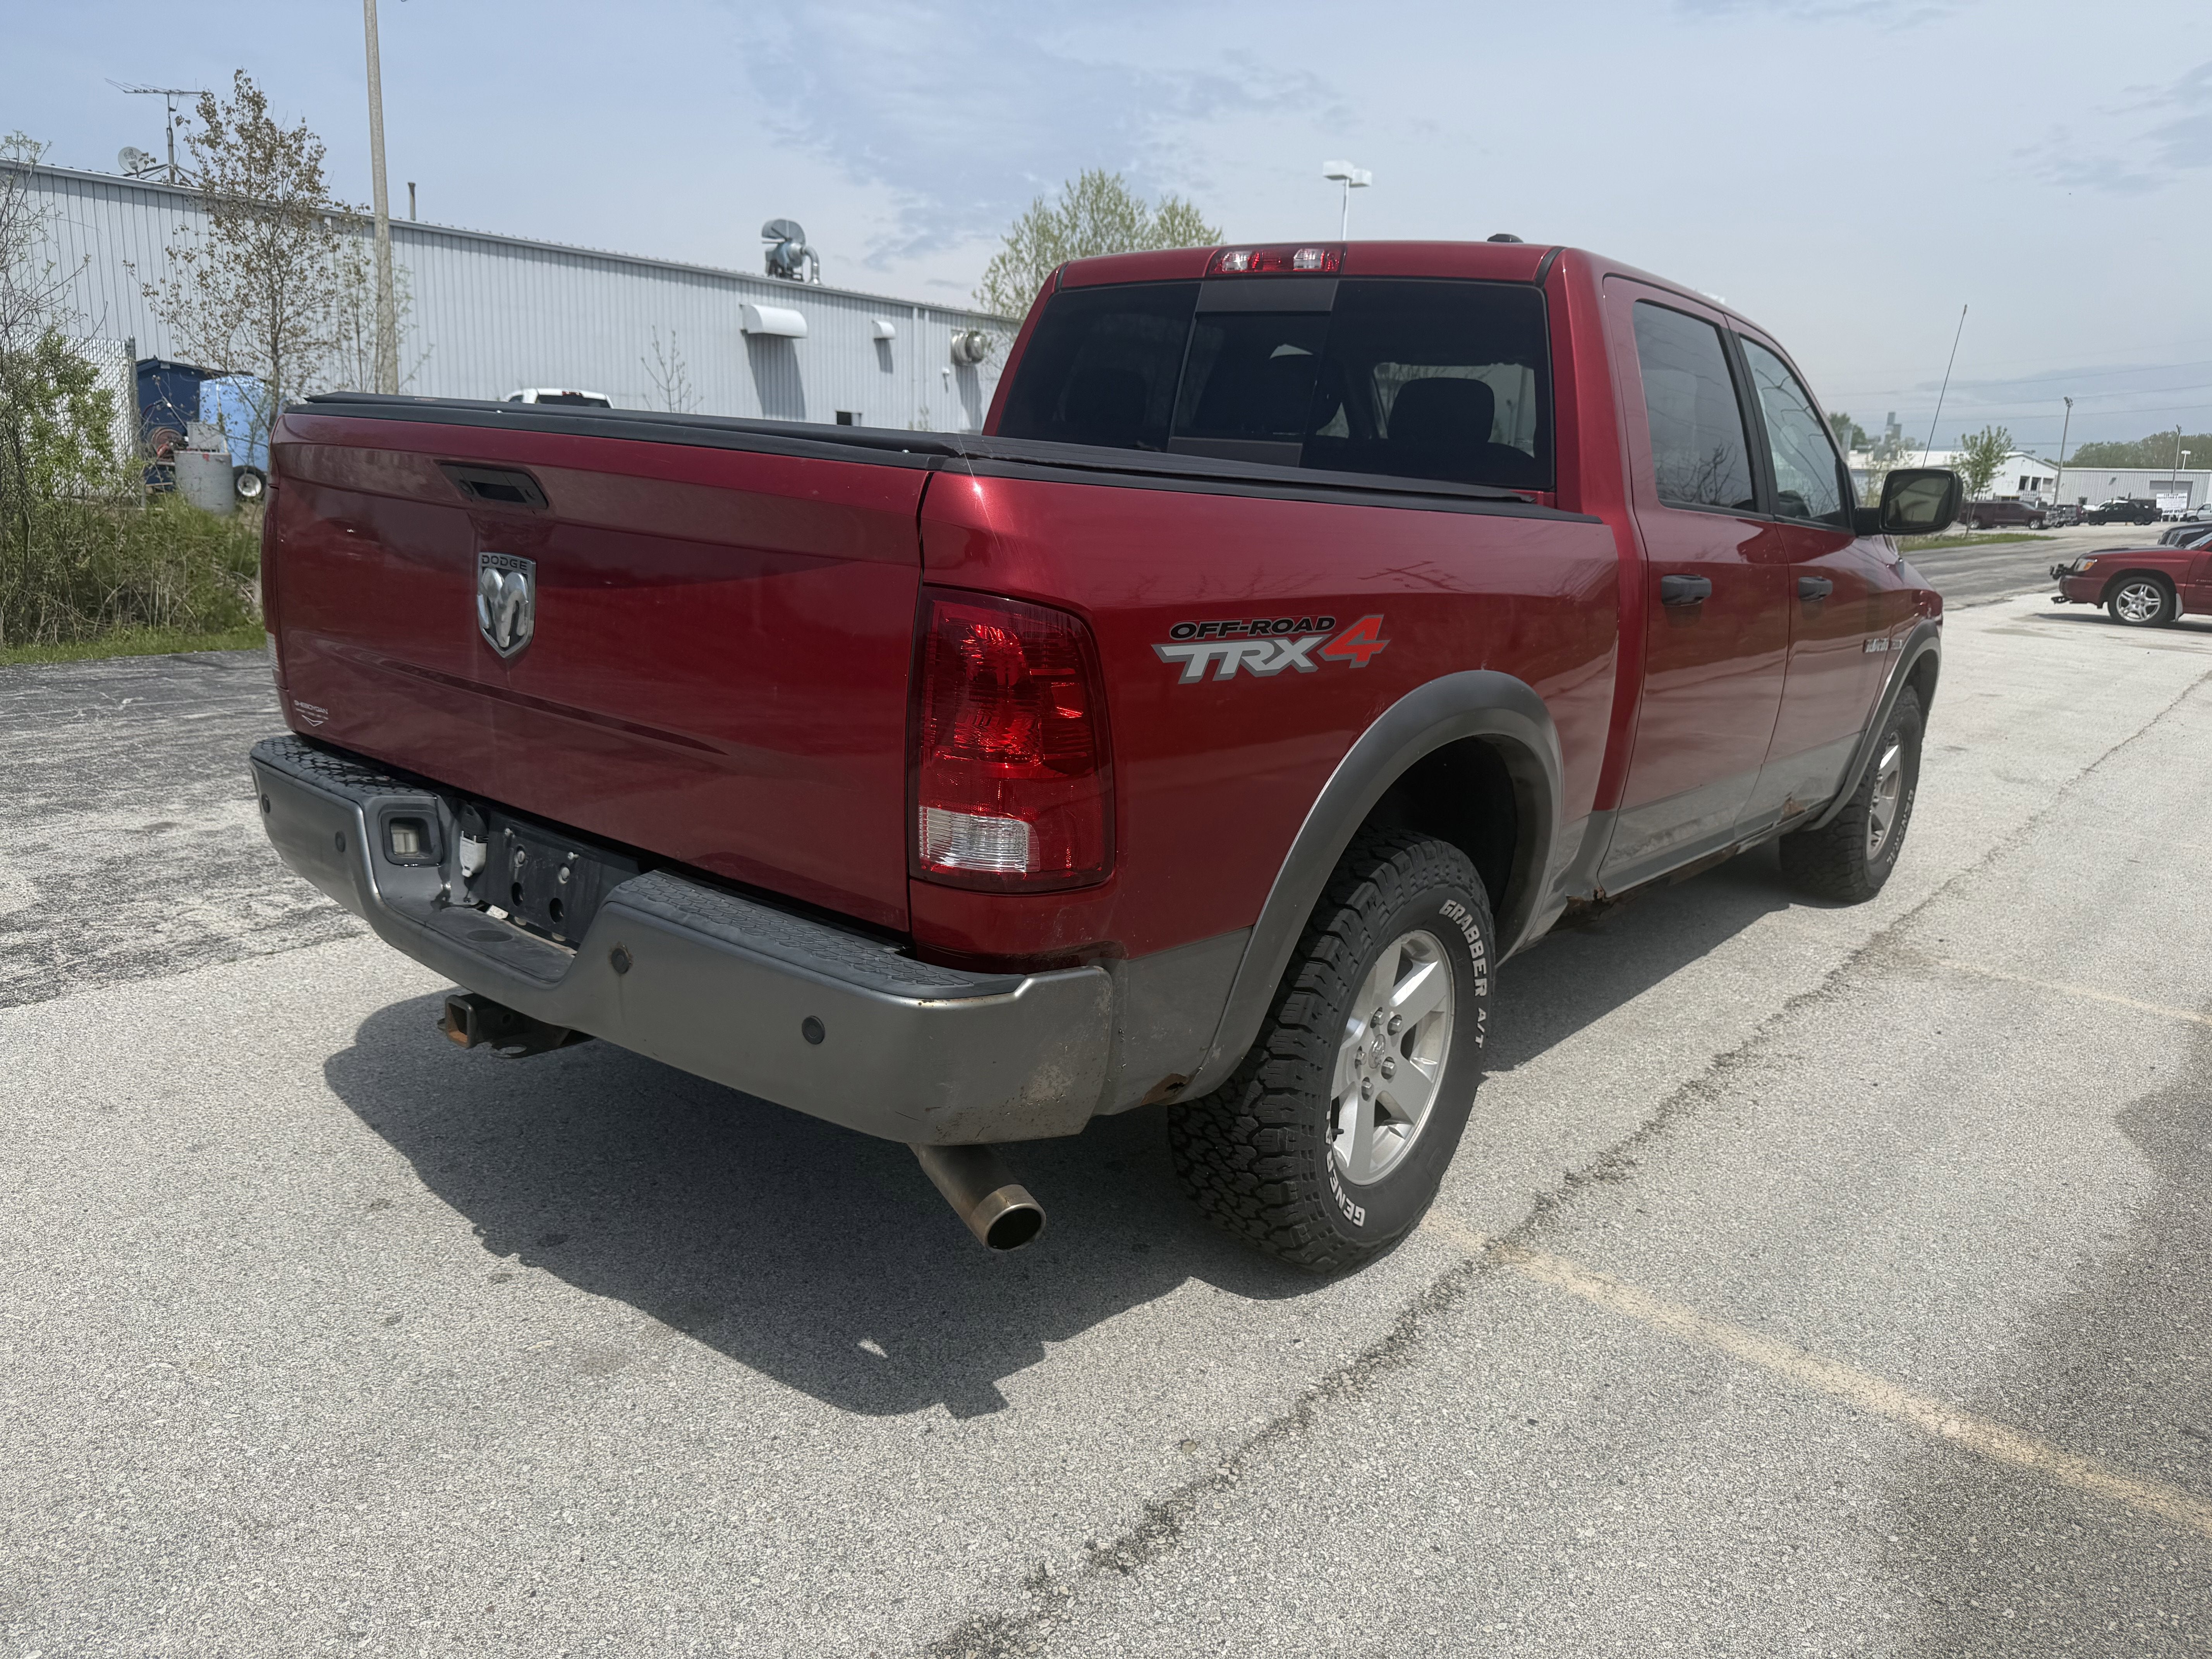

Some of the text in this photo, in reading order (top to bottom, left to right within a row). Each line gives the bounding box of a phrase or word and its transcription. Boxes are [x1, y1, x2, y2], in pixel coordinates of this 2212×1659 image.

[481, 555, 527, 571] DODGE
[1170, 617, 1336, 640] OFF-ROAD
[1439, 899, 1487, 1048] GRABBER A/T
